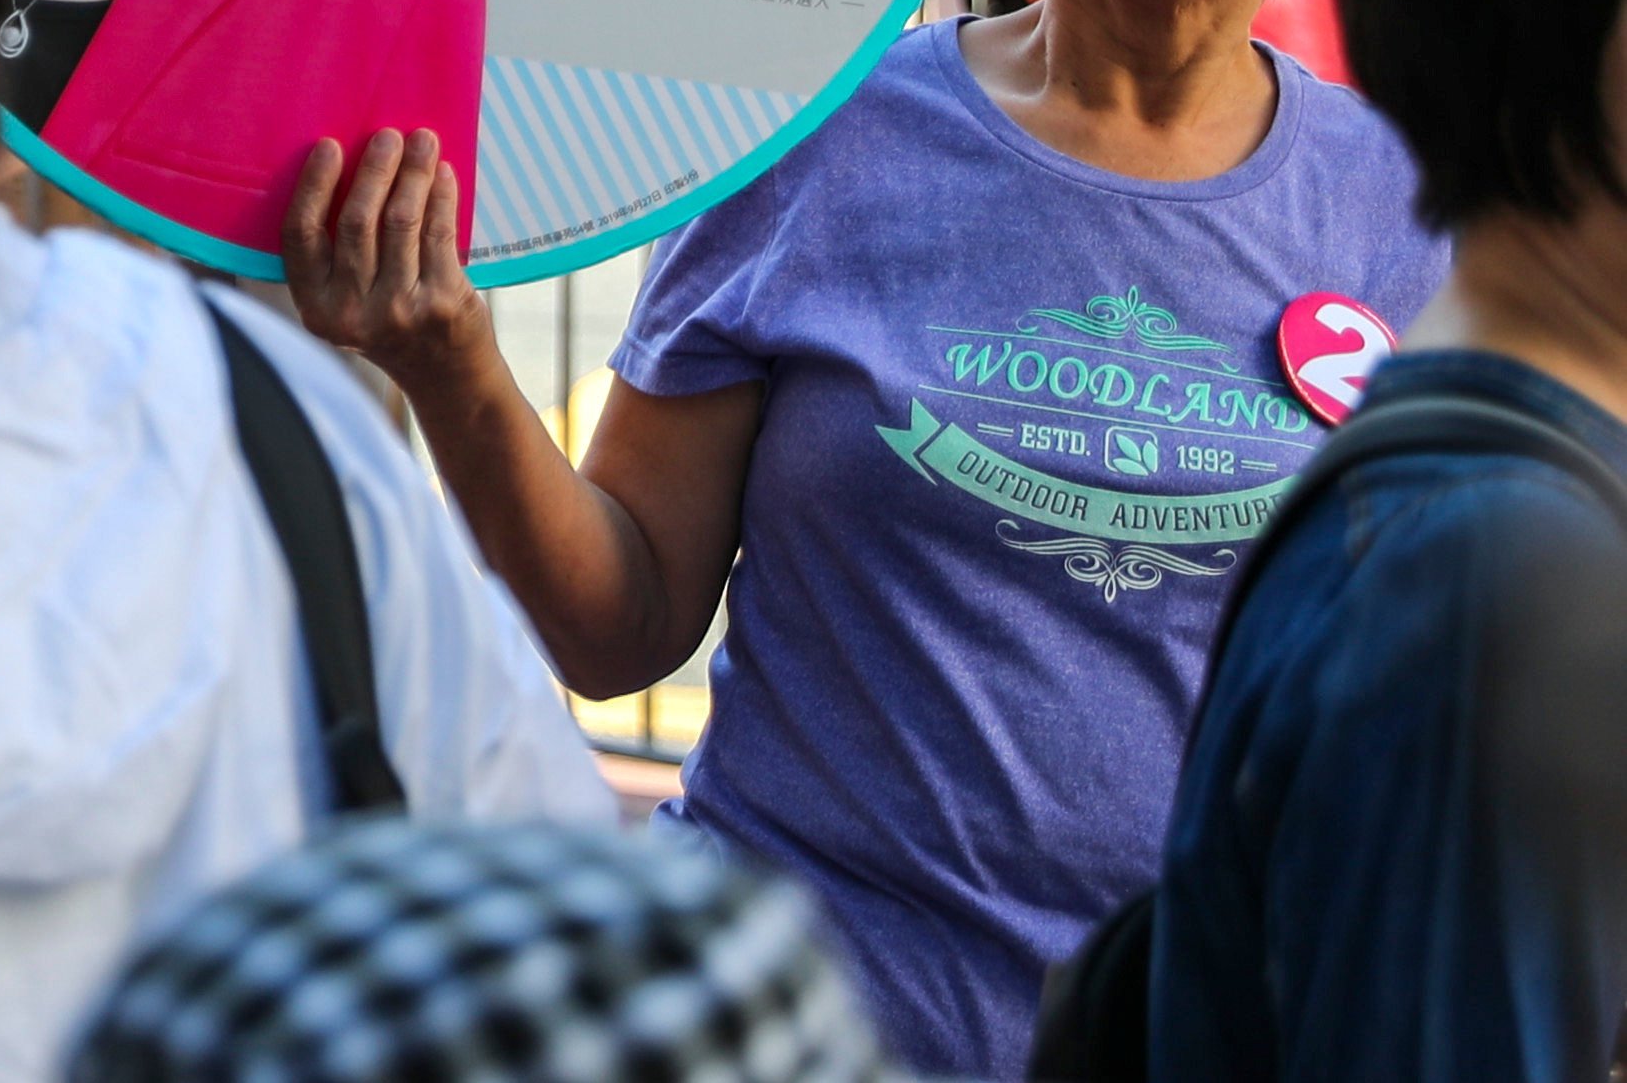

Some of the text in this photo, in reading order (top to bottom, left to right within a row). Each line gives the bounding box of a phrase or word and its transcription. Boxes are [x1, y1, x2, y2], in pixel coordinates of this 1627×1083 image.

[1296, 302, 1393, 410] 2
[1019, 423, 1235, 475] ESTD. 1992
[956, 450, 1089, 522] OUTDOOR
